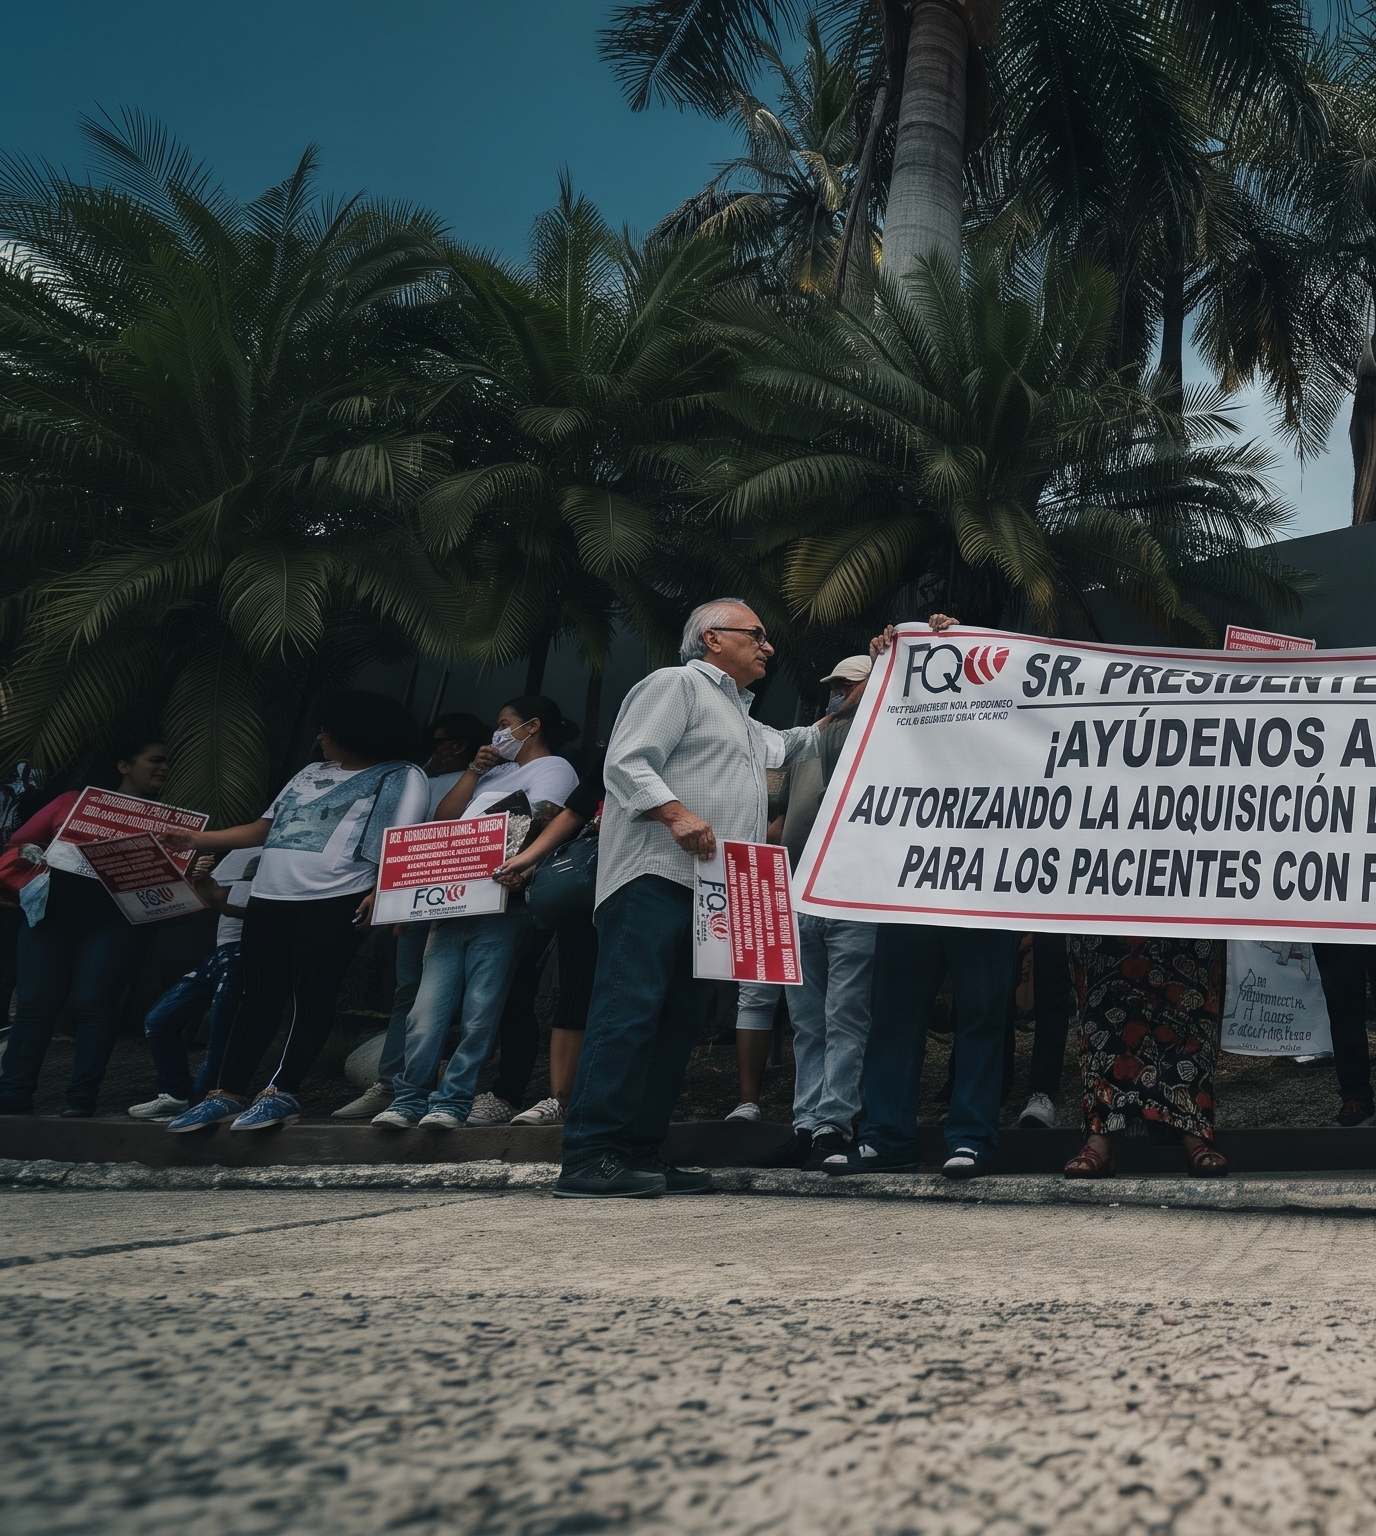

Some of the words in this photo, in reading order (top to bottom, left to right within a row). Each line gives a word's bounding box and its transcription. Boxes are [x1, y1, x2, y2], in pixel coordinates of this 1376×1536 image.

[903, 643, 964, 698] FQ
[1022, 653, 1086, 698] SR.
[1044, 706, 1325, 779] ¡AYÚDENOS
[1340, 718, 1376, 767] A
[847, 784, 1073, 830] AUTORIZANDO
[1079, 785, 1119, 830] LA
[1126, 773, 1356, 836] ADQUISICIÓN
[897, 844, 985, 892] PARA
[993, 847, 1061, 895] LOS
[1067, 848, 1262, 900] PACIENTES
[1273, 850, 1350, 902] CON
